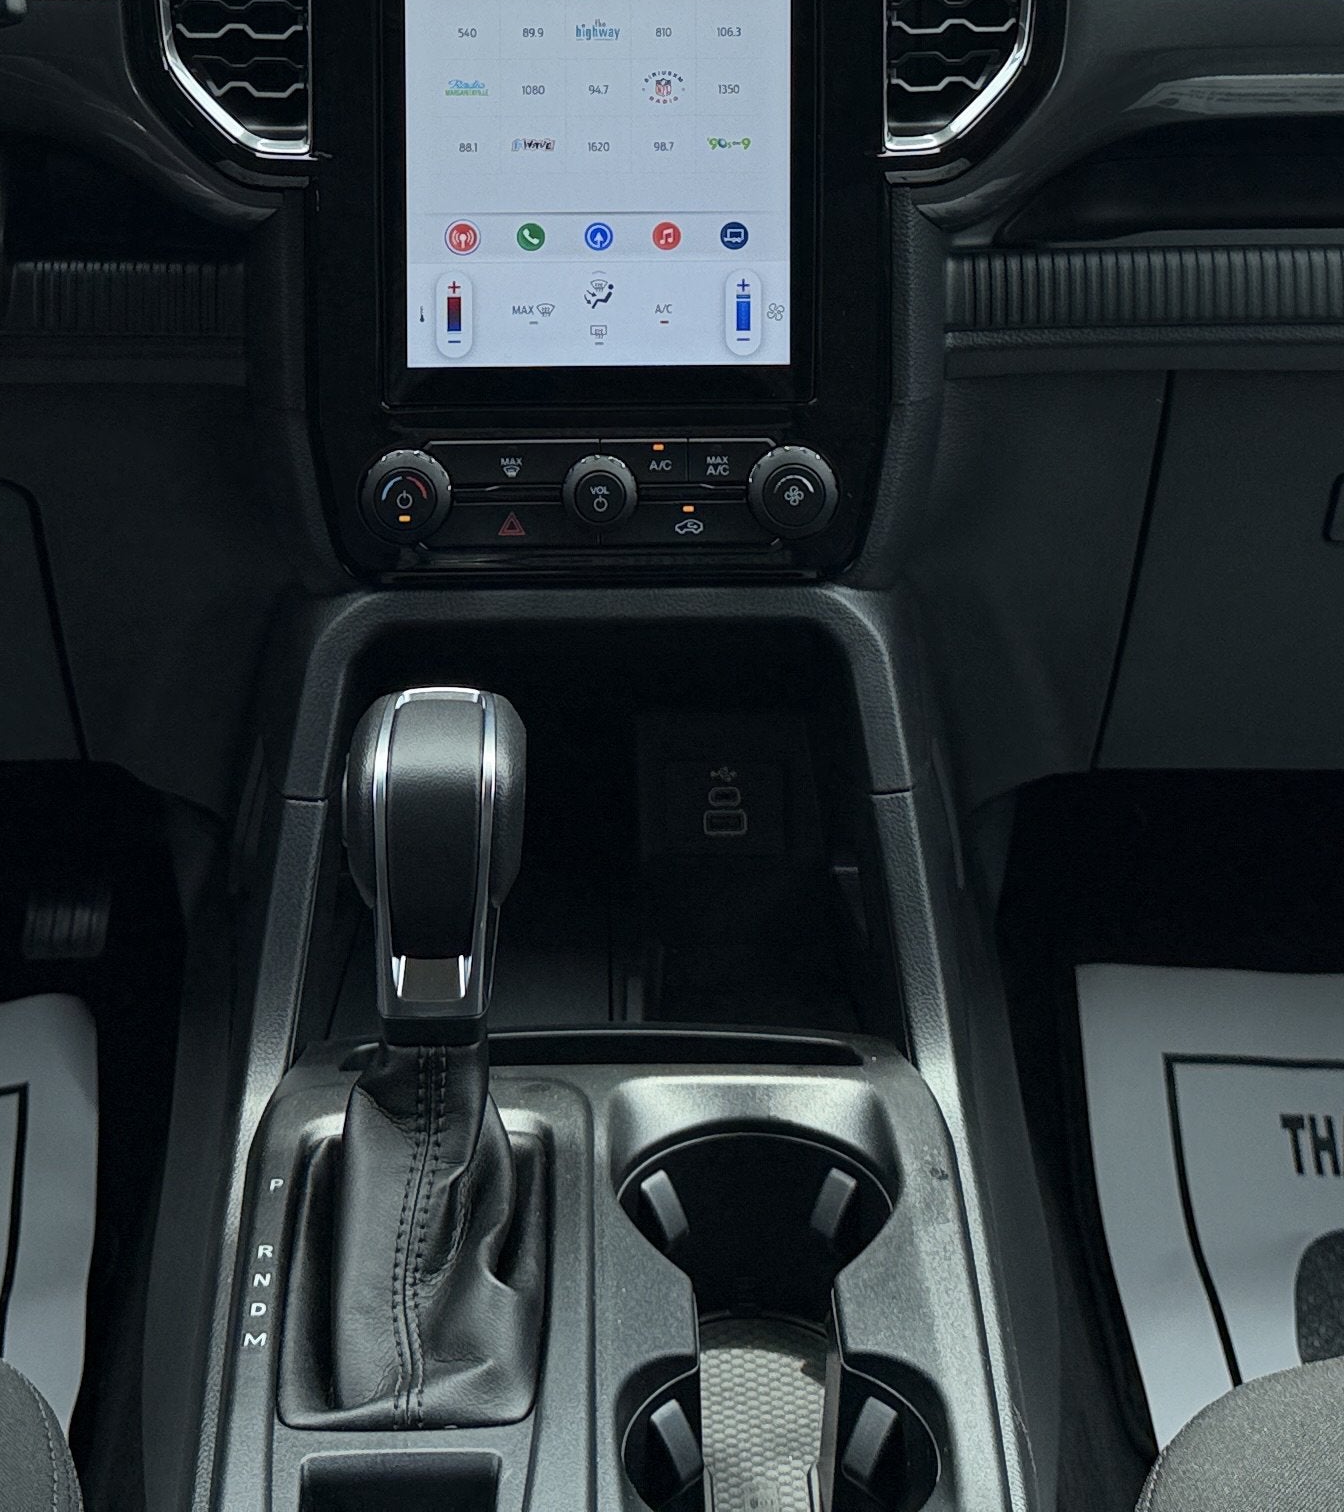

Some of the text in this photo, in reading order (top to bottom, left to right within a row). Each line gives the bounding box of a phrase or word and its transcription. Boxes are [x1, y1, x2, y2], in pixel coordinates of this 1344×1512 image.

[458, 27, 477, 39] 540
[522, 27, 544, 38] 89.9
[576, 24, 620, 40] highway
[656, 27, 672, 37] 810
[717, 27, 742, 37] 106.3
[522, 85, 545, 95] 1080
[588, 85, 609, 94] 94.7
[718, 84, 740, 94] 1350
[459, 142, 477, 153] 88.1
[587, 141, 610, 152] 1620
[654, 141, 674, 152] 98.7
[512, 305, 534, 316] MAX
[655, 304, 673, 316] A/C
[500, 458, 522, 467] MAX
[649, 459, 672, 472] A/C
[706, 456, 729, 464] MAX
[706, 464, 729, 476] A/C
[590, 486, 610, 495] VOL
[269, 1178, 284, 1192] P
[257, 1244, 274, 1259] R
[253, 1273, 271, 1287] N
[250, 1303, 267, 1317] D
[243, 1332, 268, 1346] M
